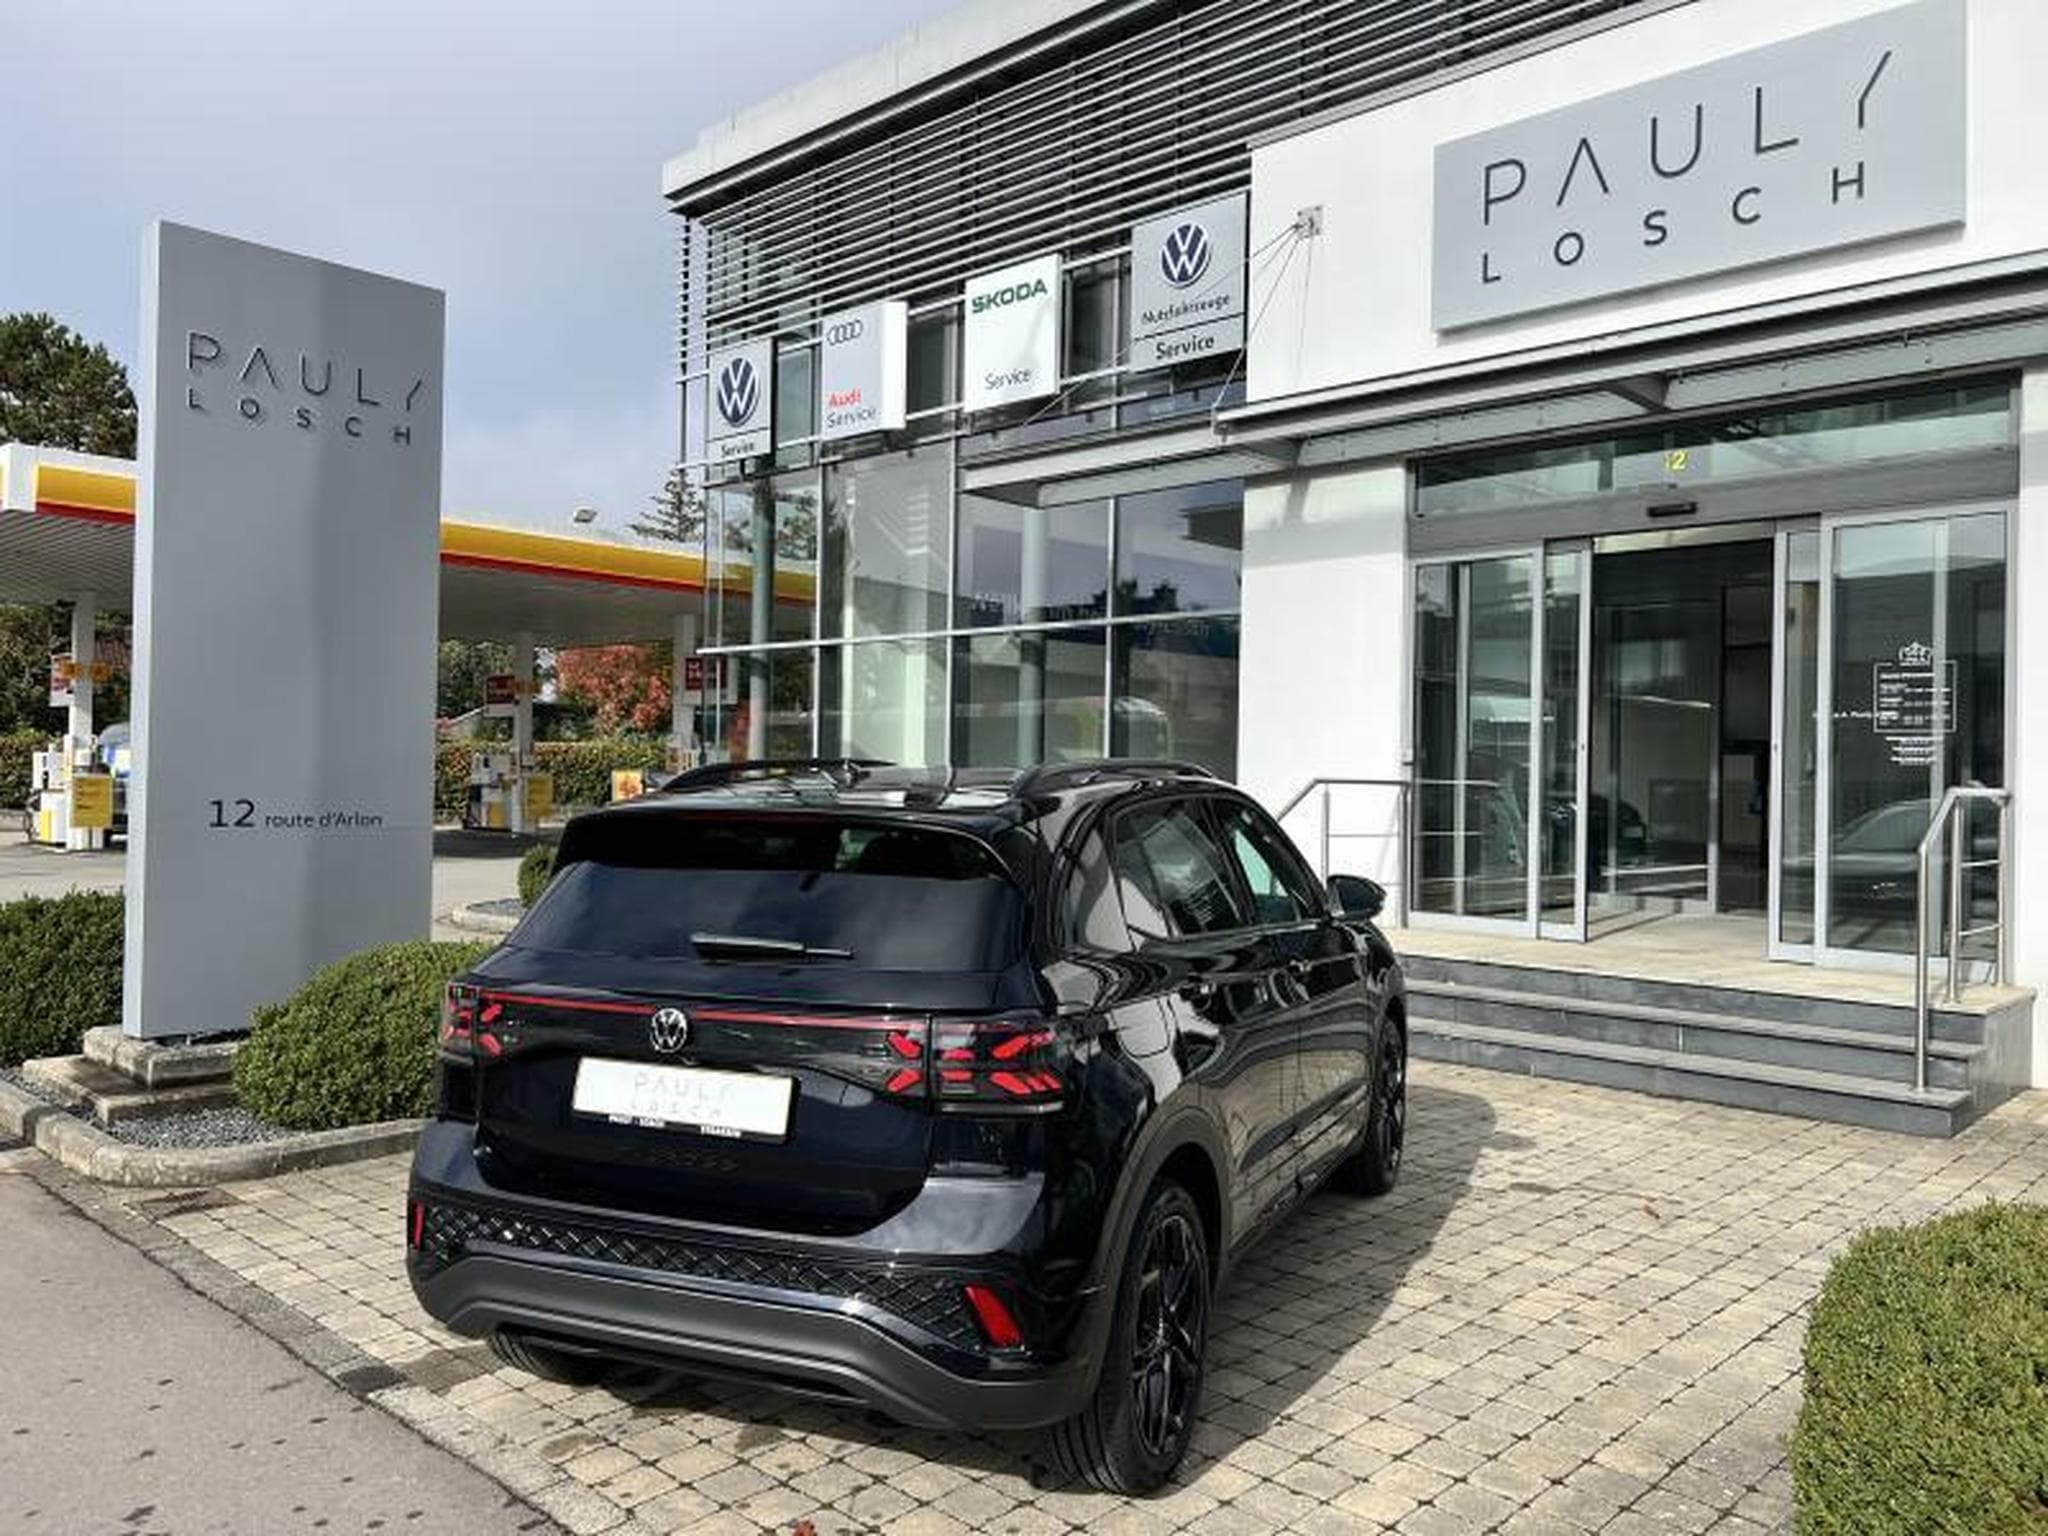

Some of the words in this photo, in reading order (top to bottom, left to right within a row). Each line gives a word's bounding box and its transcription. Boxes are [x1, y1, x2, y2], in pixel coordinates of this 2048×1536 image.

[1484, 50, 1892, 226] PAULY
[1482, 160, 1865, 284] LOSCH
[1143, 294, 1230, 324] Nutzfahrzeuge
[1156, 334, 1215, 360] Service
[187, 331, 423, 411] PAULY
[984, 368, 1032, 390] Service
[828, 388, 862, 407] Audi
[188, 388, 411, 445] LOSCH
[826, 407, 878, 428] Service
[721, 442, 755, 458] Service
[209, 798, 256, 828] 12
[265, 813, 315, 828] route
[319, 811, 383, 828] d'Arlon
